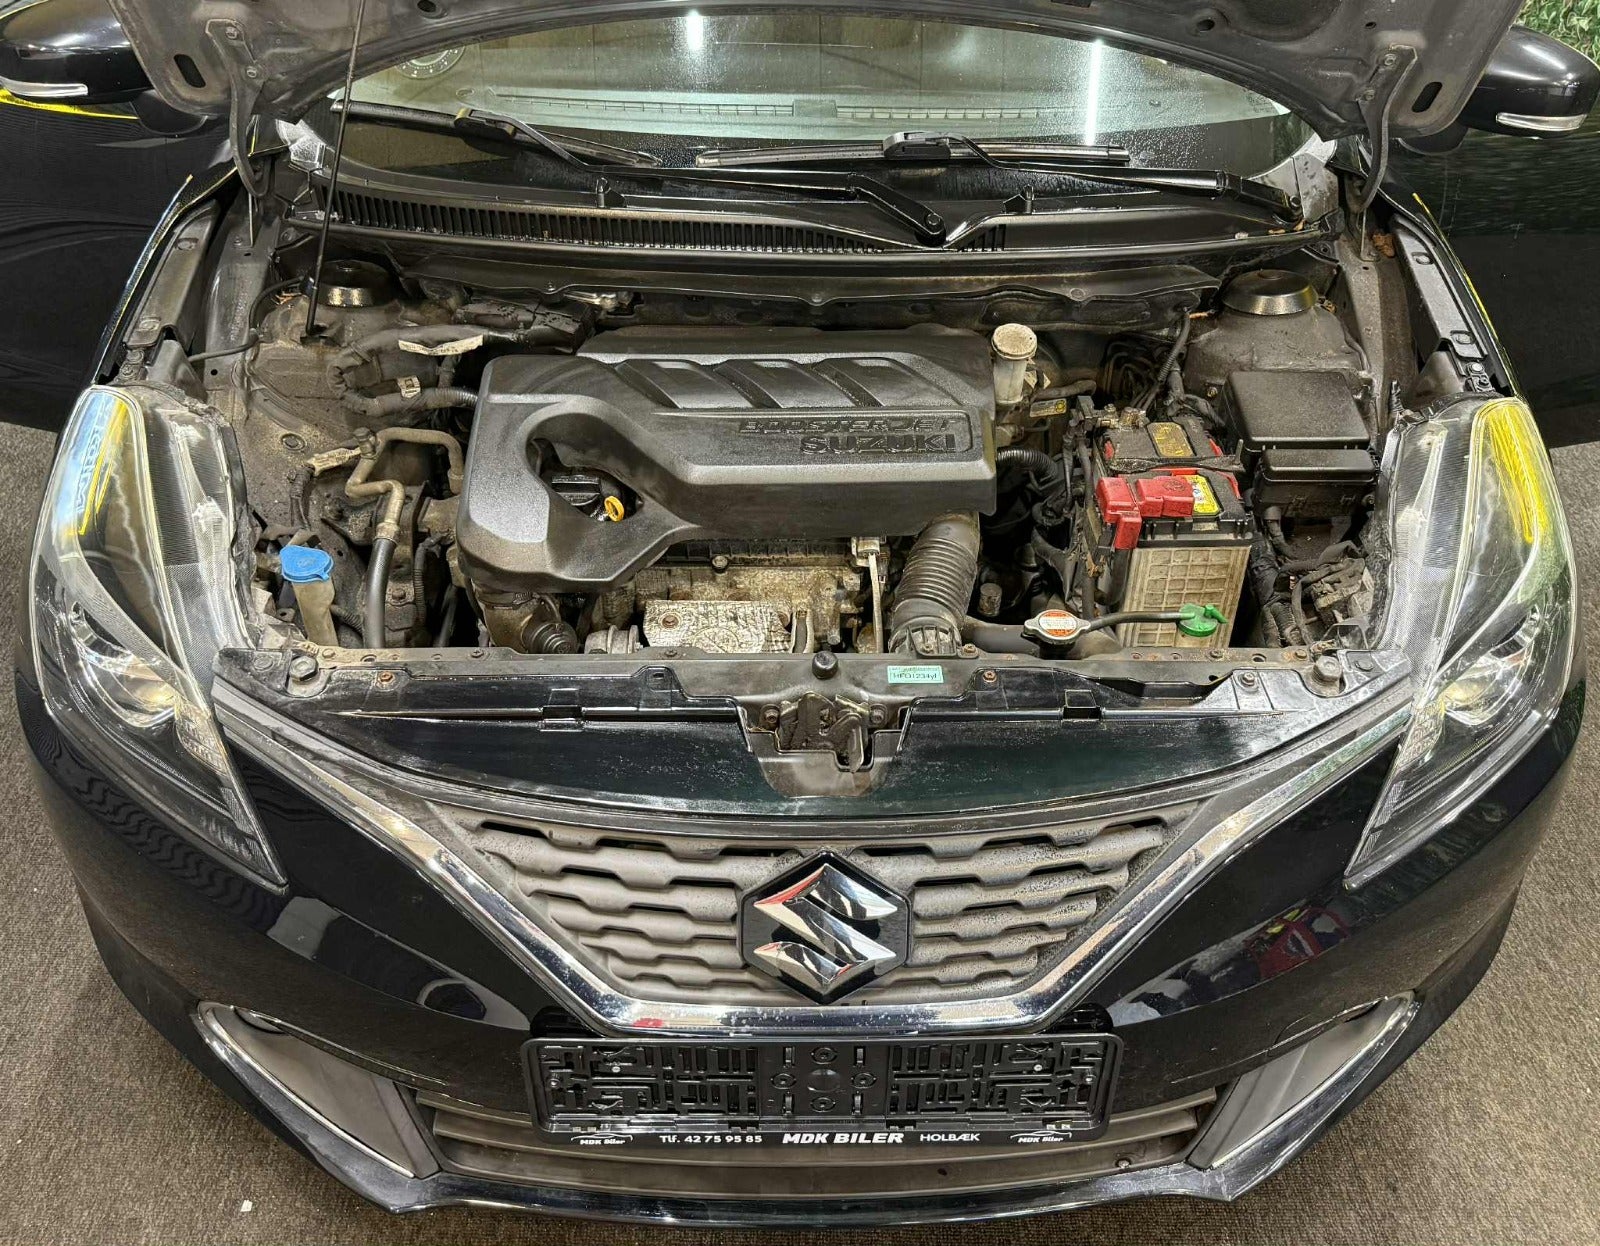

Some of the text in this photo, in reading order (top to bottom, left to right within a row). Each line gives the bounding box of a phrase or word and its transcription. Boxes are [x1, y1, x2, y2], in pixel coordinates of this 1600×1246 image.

[800, 434, 957, 454] SUZUKI
[659, 1135, 763, 1143] Tlf. 42 75 95 85
[782, 1132, 905, 1145] MDK BILER
[919, 1133, 980, 1142] HOLBÆK
